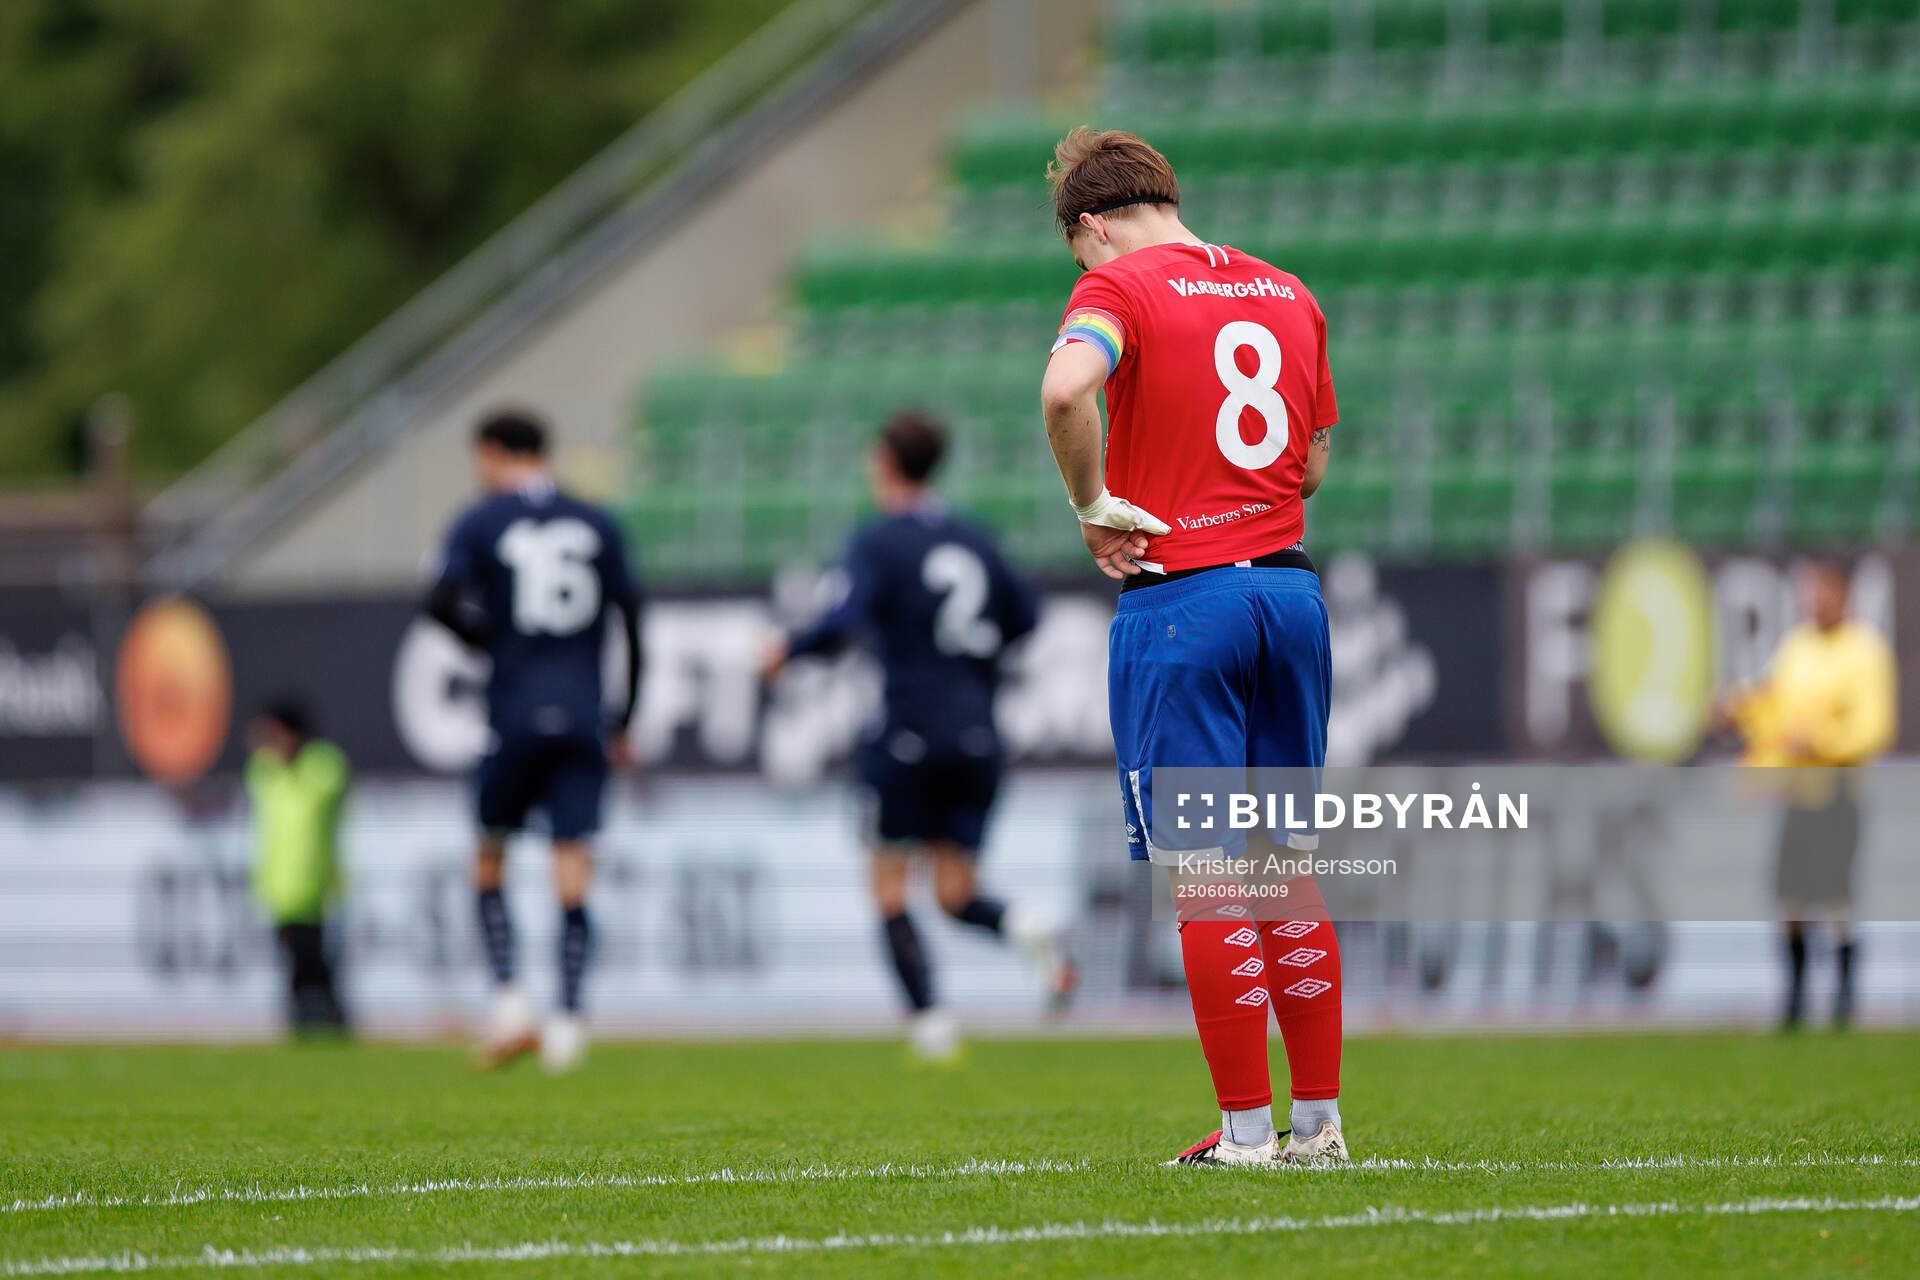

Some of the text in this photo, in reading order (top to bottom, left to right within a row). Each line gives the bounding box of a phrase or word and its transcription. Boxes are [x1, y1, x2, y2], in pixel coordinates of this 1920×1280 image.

[1214, 321, 1289, 470] 8
[500, 517, 601, 636] 16
[1176, 508, 1241, 531] Varbergs
[923, 543, 1001, 658] 2
